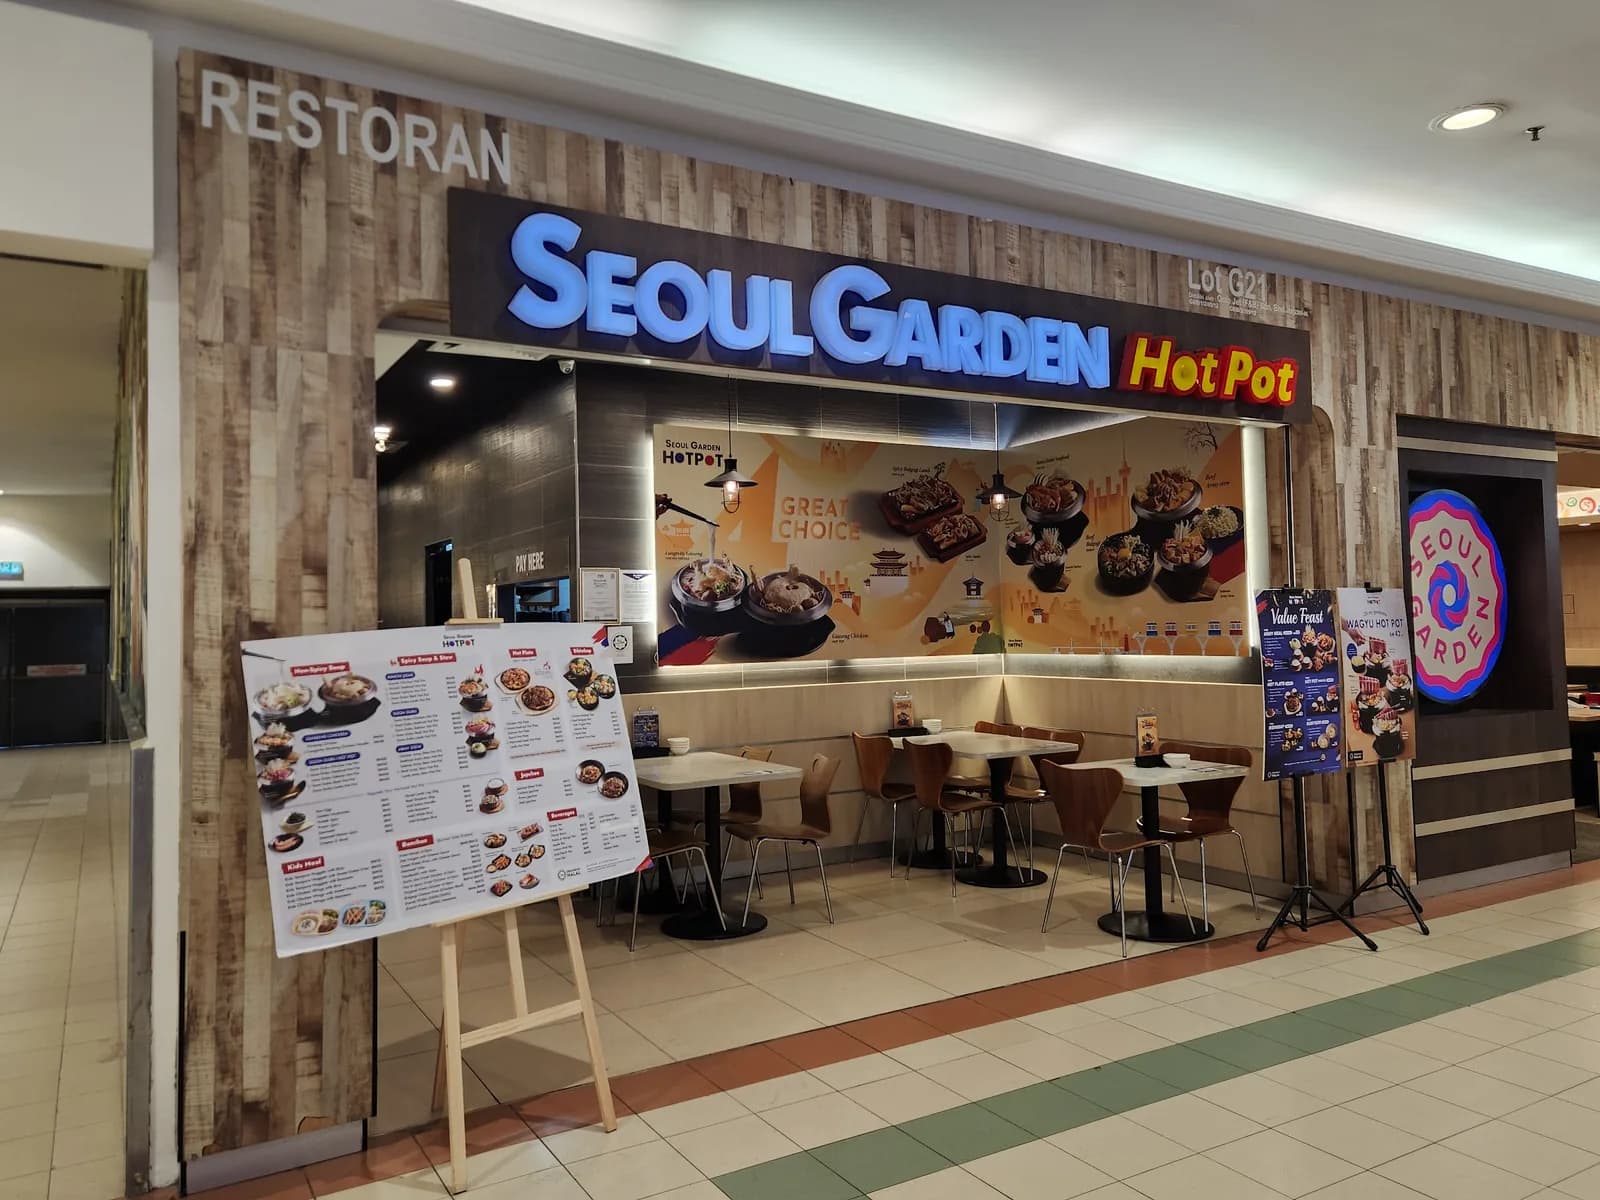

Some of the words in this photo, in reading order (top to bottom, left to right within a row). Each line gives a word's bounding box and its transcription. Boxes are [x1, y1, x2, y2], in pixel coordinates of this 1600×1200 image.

[201, 69, 511, 185] RESTORAN
[1188, 259, 1222, 294] Lot
[1228, 267, 1268, 305] G21
[507, 212, 814, 357] SEOUL
[809, 265, 1110, 388] GARDEN
[1129, 337, 1218, 394] Hot
[1224, 350, 1295, 402] Pot
[665, 439, 689, 450] SEOUL
[690, 441, 721, 452] GARDEN
[781, 496, 849, 517] GREAT
[779, 519, 861, 541] CHOICE
[516, 555, 527, 573] PAY
[528, 551, 545, 571] HERE
[1410, 527, 1483, 579] SEOUL
[1271, 607, 1298, 625] Value
[1299, 607, 1324, 624] Feast
[1347, 619, 1374, 629] WAGYU
[1376, 619, 1389, 629] HOT
[1391, 619, 1403, 629] POT
[1412, 595, 1490, 665] GARDEN
[401, 657, 417, 665] Spicy
[287, 863, 303, 872] Kids
[304, 858, 322, 868] Meal
